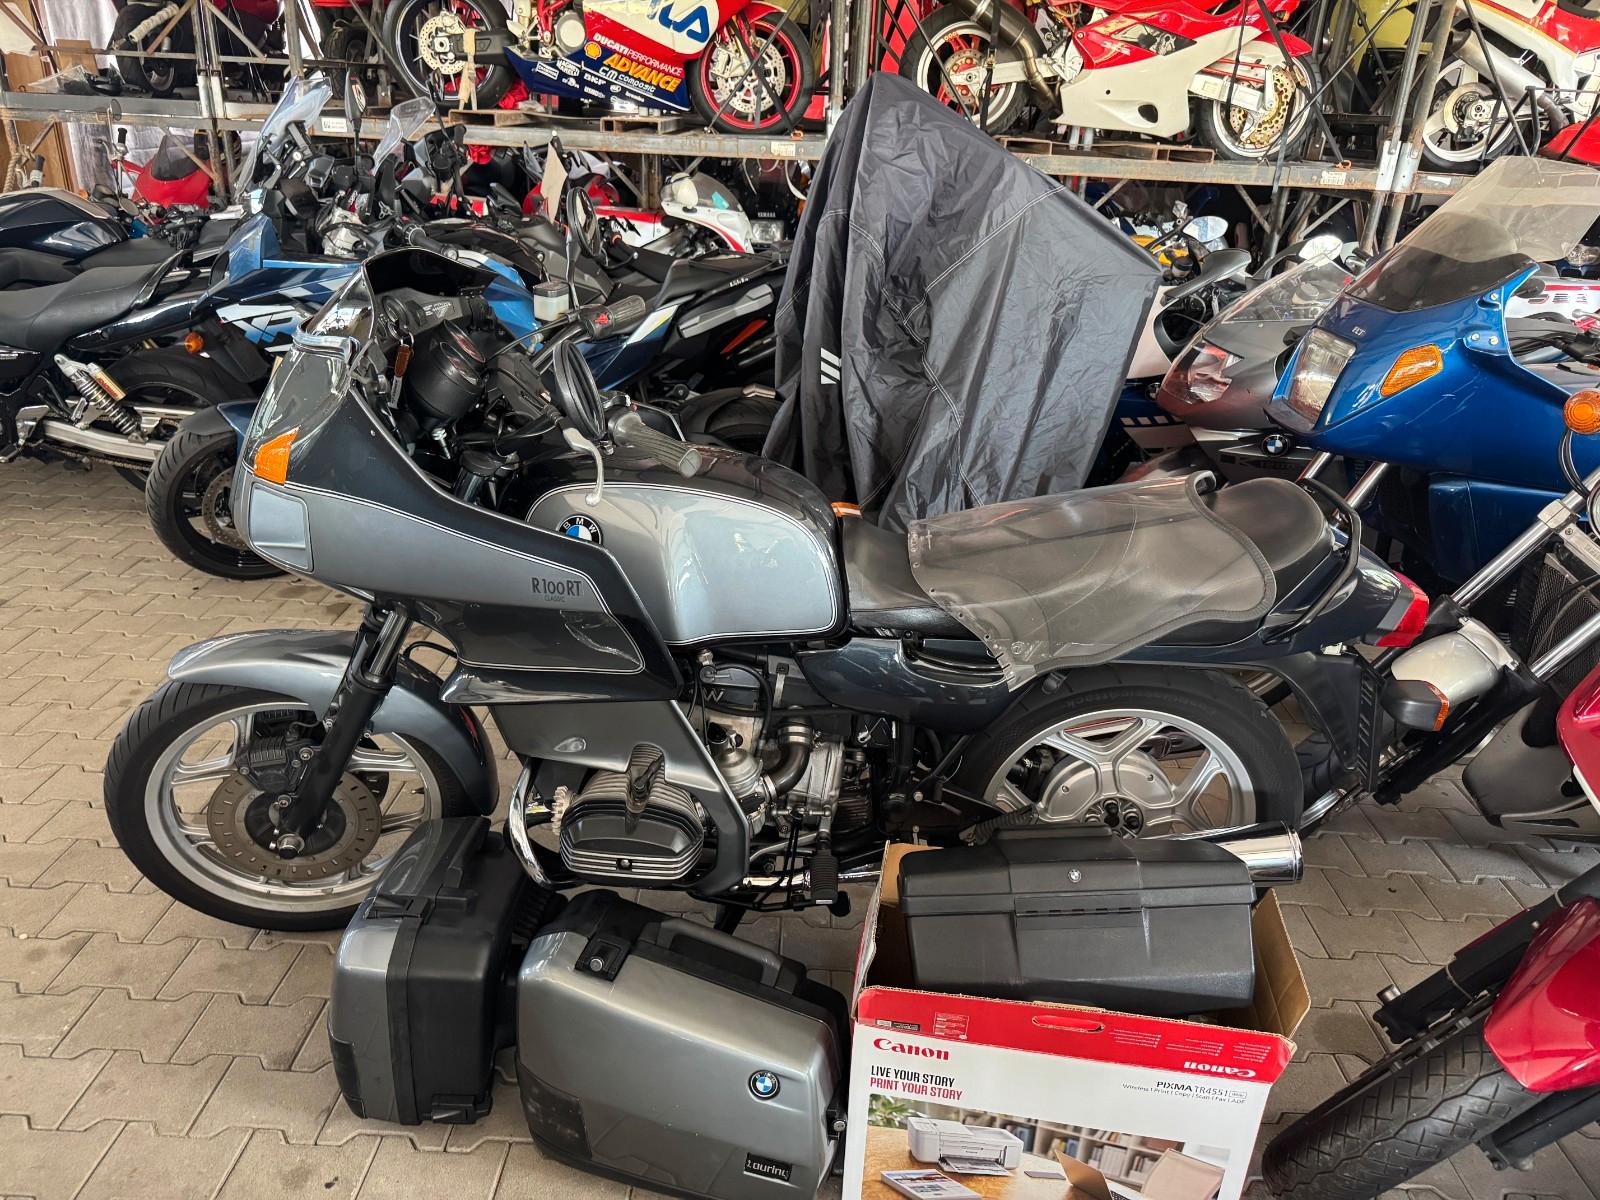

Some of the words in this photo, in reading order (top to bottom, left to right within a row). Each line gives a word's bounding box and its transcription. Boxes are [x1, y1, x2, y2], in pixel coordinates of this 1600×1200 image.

[593, 33, 629, 56] DUCATI
[627, 48, 684, 76] PERFORMANCE
[603, 53, 682, 93] ADVANCE
[563, 517, 597, 534] BMW
[873, 1038, 949, 1061] Canon
[871, 1065, 892, 1078] LIVE
[893, 1068, 920, 1083] YOUR
[922, 1073, 955, 1088] STORY
[1183, 1061, 1256, 1078] Canon
[870, 1077, 900, 1091] PRINT
[902, 1081, 928, 1096] YOUR
[929, 1086, 963, 1101] STORY
[1156, 1081, 1193, 1092] PIXMA
